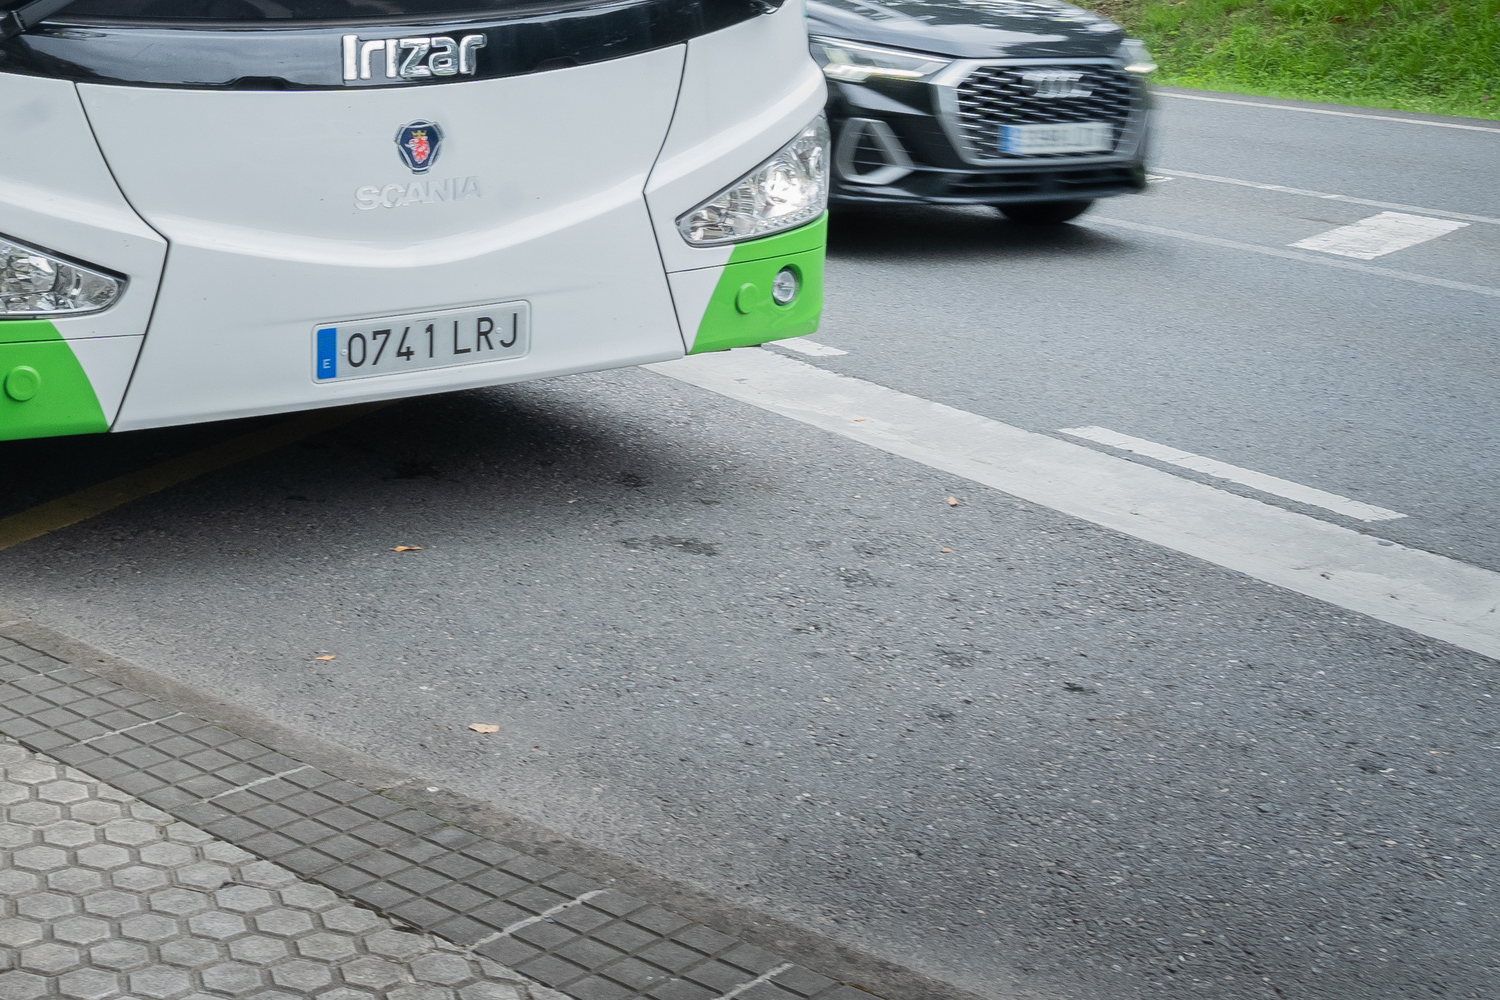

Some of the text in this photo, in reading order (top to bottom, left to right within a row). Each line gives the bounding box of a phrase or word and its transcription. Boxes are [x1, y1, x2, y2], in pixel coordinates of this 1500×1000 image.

[342, 34, 486, 81] Irizar
[354, 176, 483, 210] SCANIA
[322, 312, 519, 370] E 0741 LRJ
